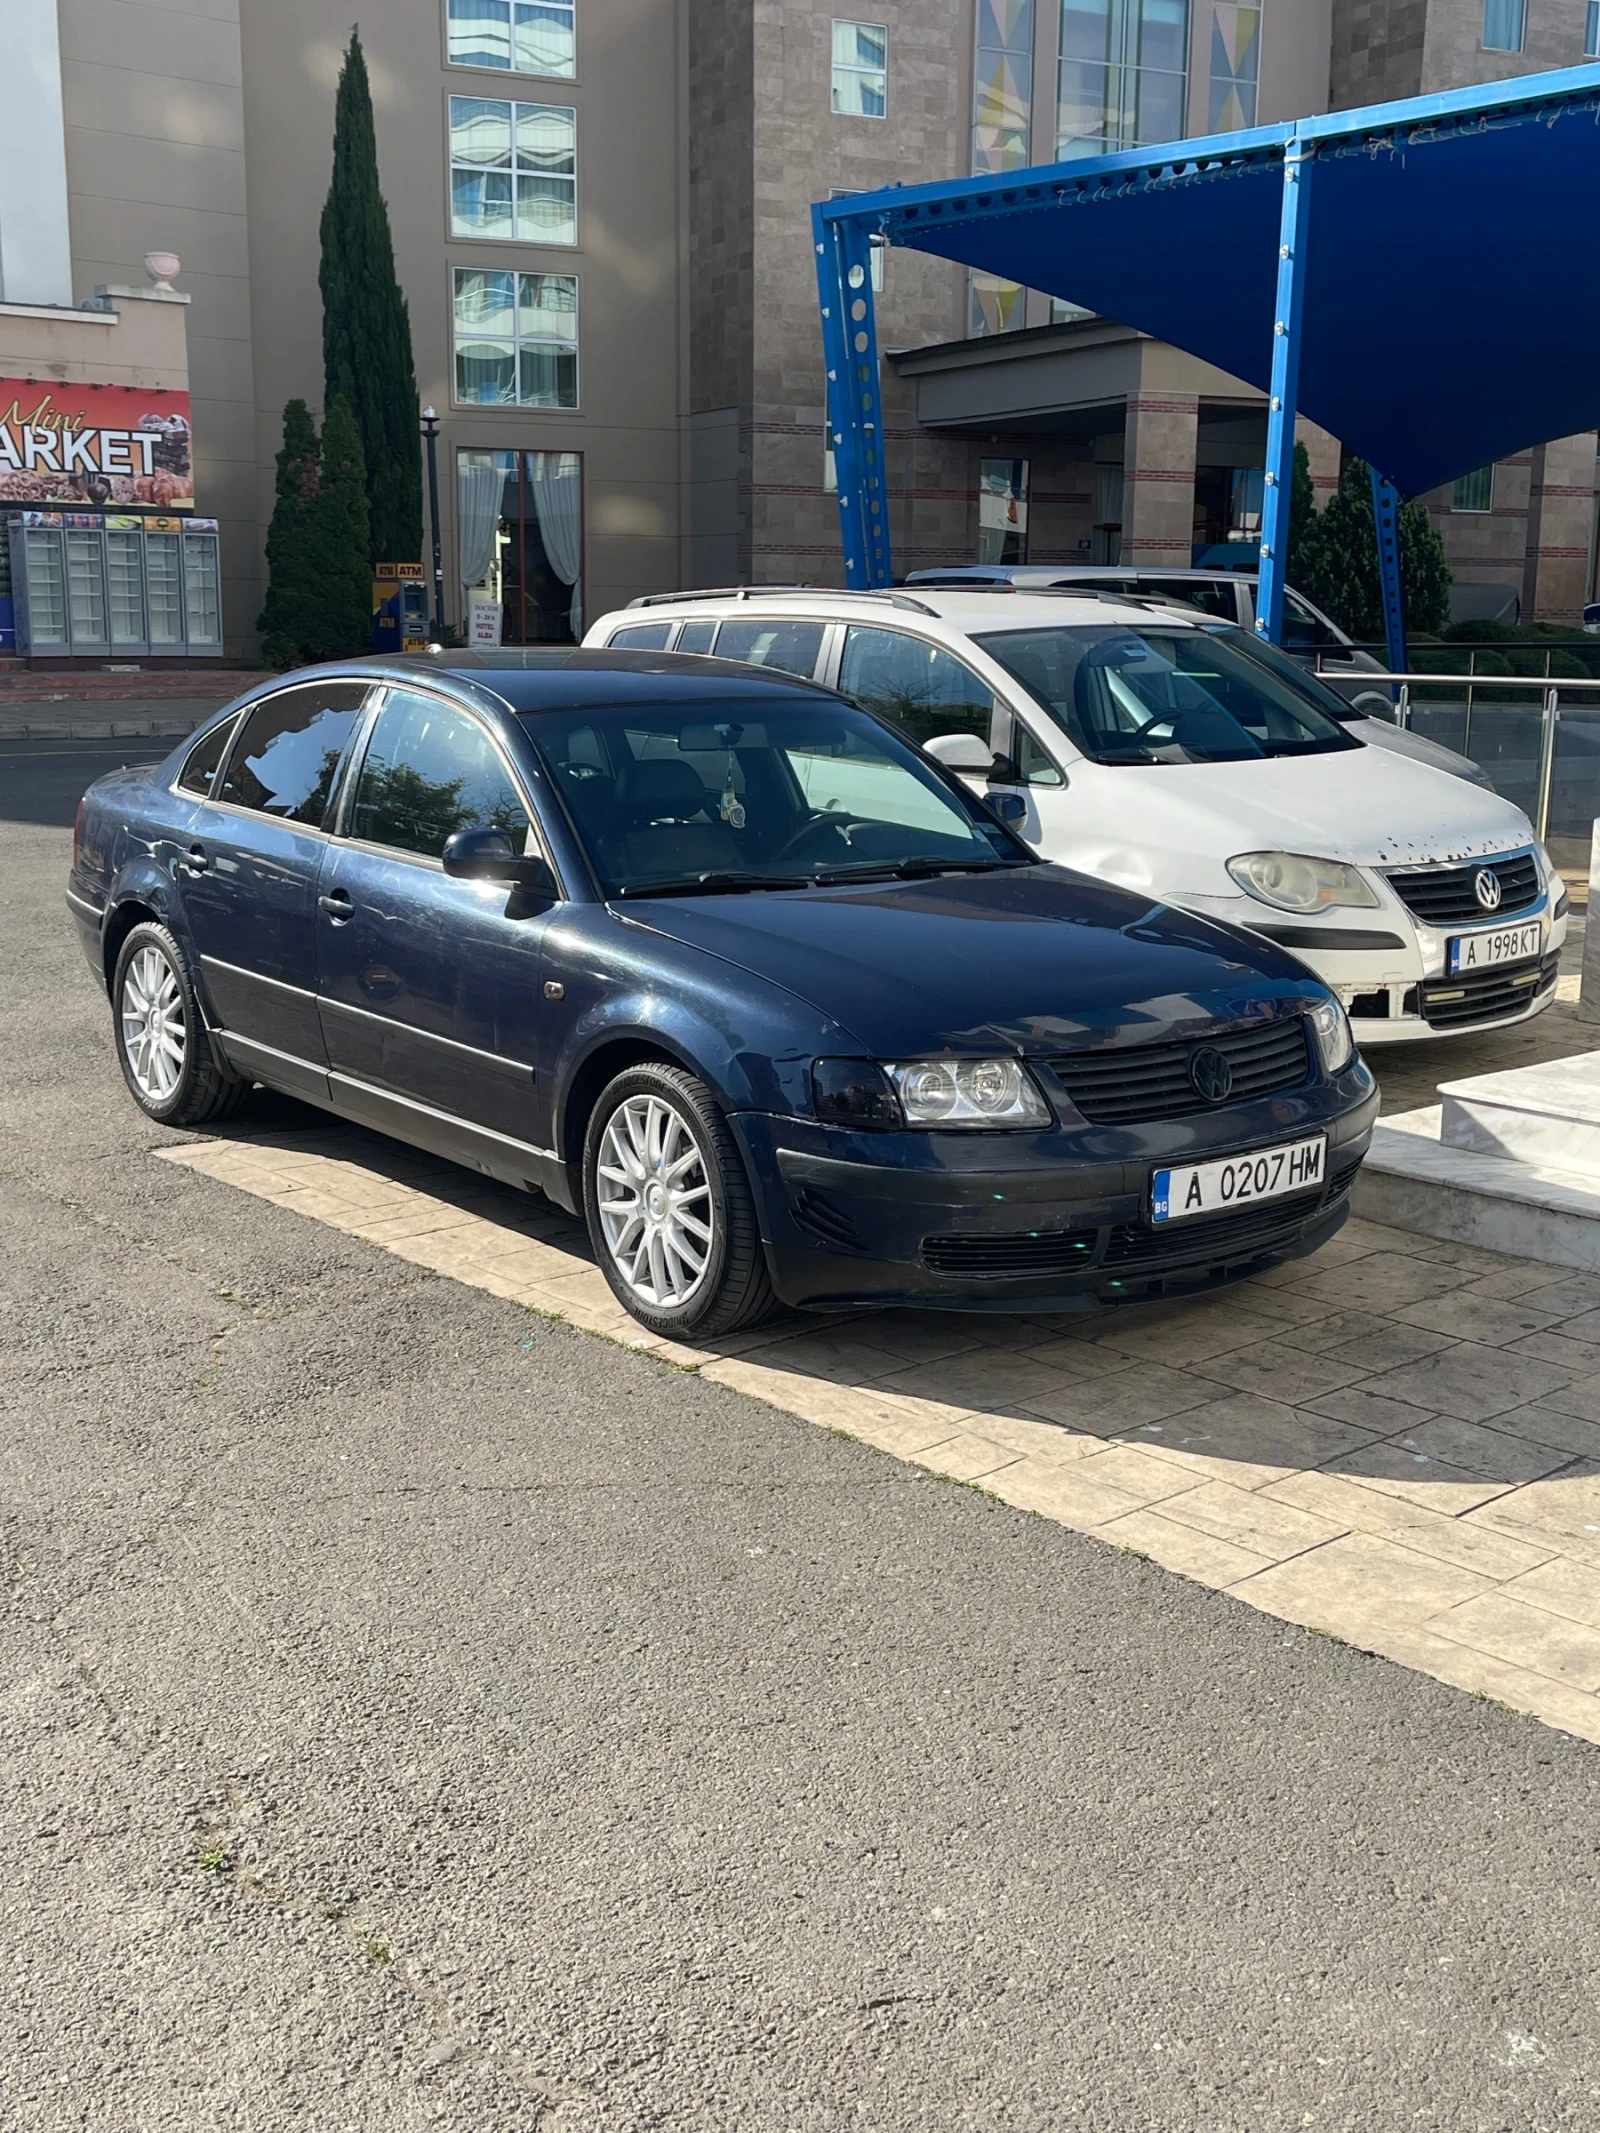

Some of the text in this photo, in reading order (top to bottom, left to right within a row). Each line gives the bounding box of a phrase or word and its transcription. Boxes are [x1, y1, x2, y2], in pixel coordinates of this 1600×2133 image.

[0, 394, 86, 434] Mini
[399, 566, 422, 576] ATM
[474, 604, 499, 612] DOCTOR
[407, 638, 426, 647] ATM
[1467, 940, 1476, 965] A
[1185, 1171, 1203, 1209] A
[1154, 1200, 1168, 1214] BG
